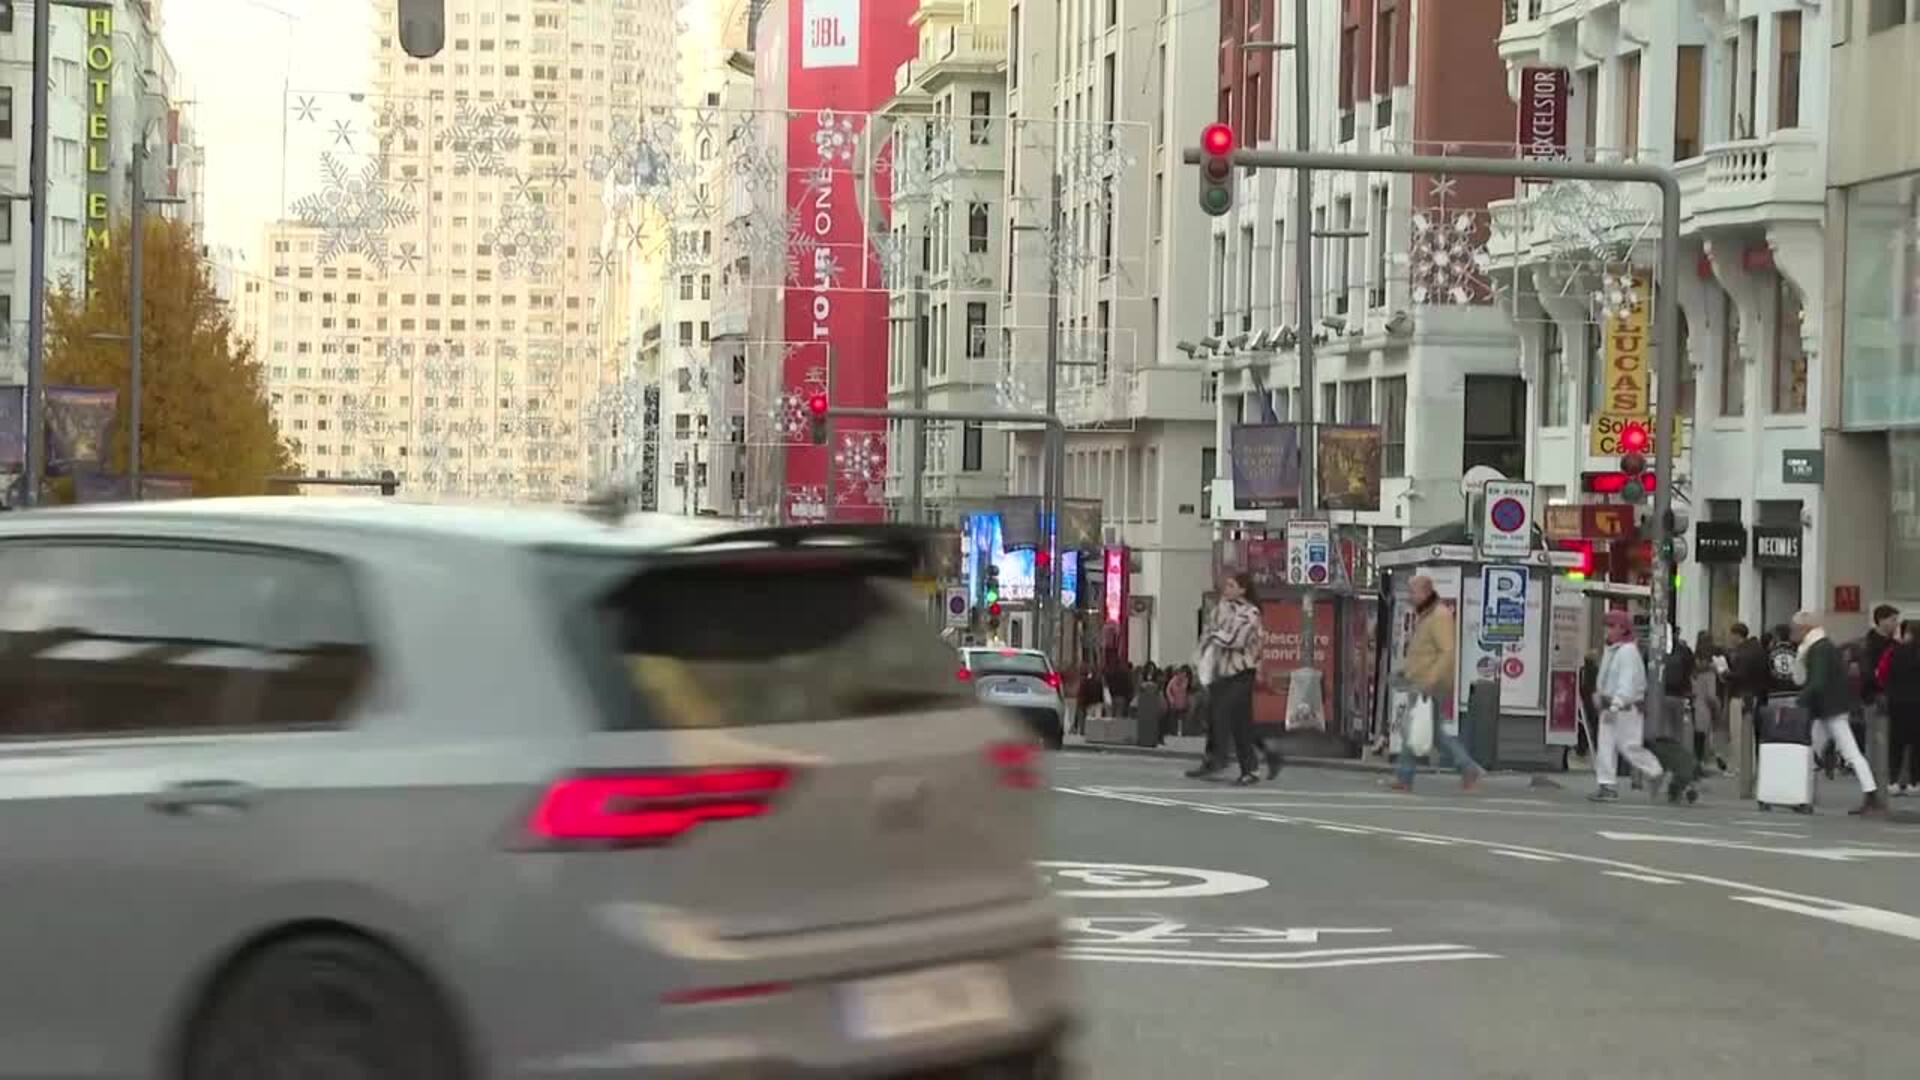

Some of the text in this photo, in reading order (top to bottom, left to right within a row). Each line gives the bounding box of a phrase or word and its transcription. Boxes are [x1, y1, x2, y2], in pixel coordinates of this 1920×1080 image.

[811, 18, 846, 48] JBL
[88, 9, 112, 172] HOTEL
[1532, 71, 1556, 155] EXCELSIOR
[816, 167, 832, 235] ONE
[813, 247, 832, 340] TOUR
